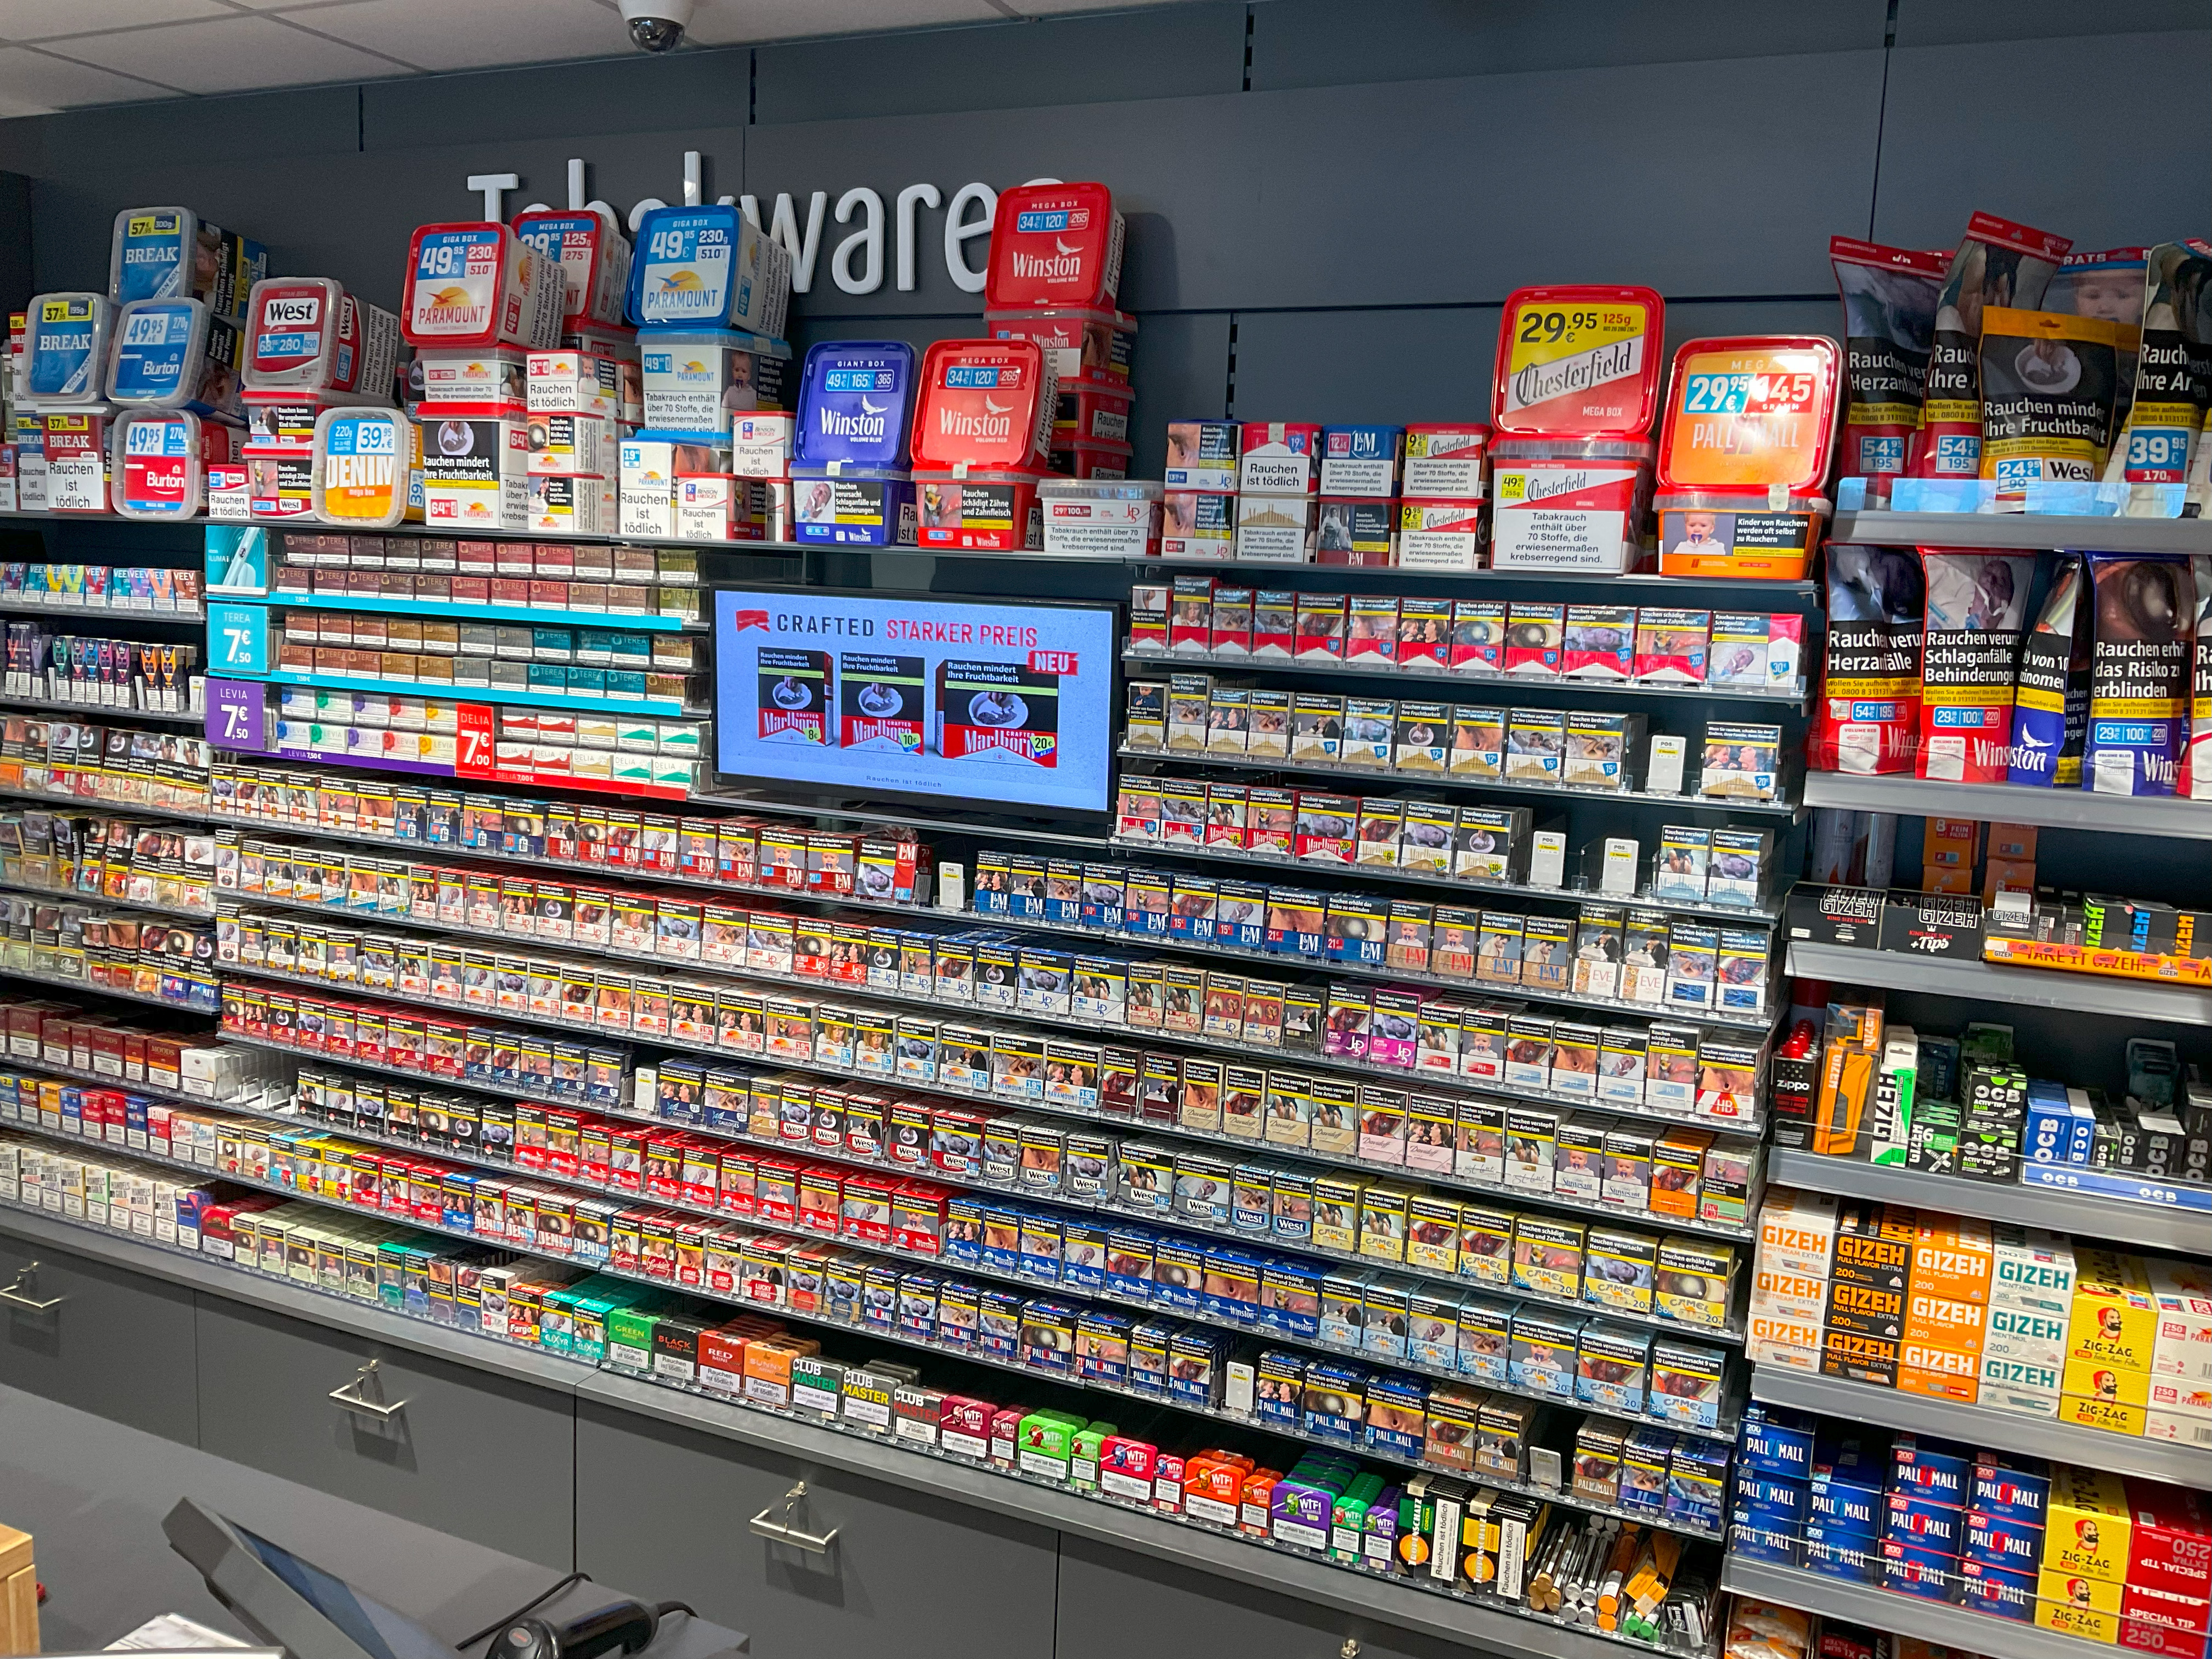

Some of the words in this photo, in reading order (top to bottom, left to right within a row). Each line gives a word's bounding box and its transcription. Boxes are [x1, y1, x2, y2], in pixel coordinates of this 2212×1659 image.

[1013, 252, 1081, 276] Winston
[648, 289, 718, 309] PARAMOUNT
[269, 302, 313, 322] West
[419, 306, 486, 324] PARAMOUNT
[1603, 314, 1632, 326] 125g
[39, 335, 91, 351] BREAK
[1516, 342, 1630, 406] Chesterfield
[646, 394, 686, 404] Tabakrauch
[688, 394, 715, 404] enthält
[647, 404, 662, 413] über
[676, 405, 699, 414] Stoffe,
[702, 405, 713, 414] die
[1583, 407, 1605, 417] MEGA
[1607, 407, 1622, 417] BOX
[1984, 401, 2057, 417] Rauchen
[648, 415, 713, 425] erwiesenermaßen
[821, 408, 884, 436] Winston
[941, 408, 1009, 436] Winston
[1985, 419, 2014, 437] Ihre
[49, 435, 89, 448] BREAK
[1431, 438, 1470, 455] Chesterfield
[49, 462, 93, 475] Rauchen
[1250, 463, 1297, 474] Rauchen
[65, 478, 77, 491] ist
[147, 472, 184, 488] Burton
[1248, 476, 1260, 486] ist
[1262, 476, 1299, 486] tödlich
[1528, 472, 1586, 502] Chesterfield
[56, 494, 91, 508] tödlich
[621, 493, 668, 505] Rauchen
[962, 499, 988, 509] schädigt
[990, 500, 1008, 508] Zähne
[636, 508, 649, 519] ist
[836, 506, 874, 515] Behinderungen
[976, 508, 1011, 517] Zahnfleisch
[1533, 513, 1586, 522] Tabakrauch
[1738, 518, 1760, 527] Kinder
[1775, 520, 1808, 528] Rauchern
[625, 522, 661, 534] tödlich
[1531, 523, 1563, 532] enthält
[1566, 524, 1586, 532] über
[1737, 526, 1762, 535] werden
[1764, 527, 1773, 535] oft
[1775, 527, 1796, 535] selbst
[1528, 533, 1539, 541] 70
[1542, 533, 1571, 542] Stoffe,
[1575, 534, 1588, 542] die
[1746, 534, 1778, 543] Rauchern
[1516, 543, 1598, 552] erwiesenermaßen
[1510, 553, 1577, 564] krebserregend
[1581, 554, 1602, 563] sind.
[174, 572, 194, 580] VEEV
[224, 612, 250, 622] TEREA
[777, 614, 874, 637] CRAFTED
[887, 619, 972, 644] STARKER
[980, 625, 1037, 647] PREIS
[1928, 633, 1988, 646] Rauchen
[1035, 654, 1069, 672] NEU
[1828, 652, 1912, 670] Herzanfälle
[948, 662, 983, 672] Rauchen
[985, 664, 1016, 674] mindert
[2095, 662, 2124, 677] das
[2128, 662, 2168, 678] Risiko
[948, 671, 964, 680] Ihre
[966, 672, 1018, 683] Fruchtbarkeit
[220, 689, 247, 699] LEVIA
[2094, 682, 2167, 698] erblinden
[461, 714, 489, 726] DELIA
[866, 775, 898, 784] Rauchen
[915, 779, 941, 788] tödlich
[738, 863, 753, 878] L&M
[1919, 909, 1977, 928] GIZEH
[1593, 970, 1613, 981] EVE
[1778, 1080, 1809, 1091] zippo
[1976, 1085, 2021, 1103] OCB
[1717, 1098, 1734, 1113] HB
[1874, 1074, 1897, 1141] GIZEH
[783, 1124, 806, 1136] West
[2042, 1172, 2078, 1186] OCB
[2139, 1187, 2177, 1201] OCB
[1237, 1210, 1263, 1223] West
[1590, 1237, 1613, 1246] Rauchen
[1614, 1243, 1643, 1252] verursacht
[1762, 1224, 1826, 1254] GIZEH
[1589, 1243, 1620, 1254] Herzanfälle
[1838, 1235, 1905, 1265] GIZEH
[1661, 1252, 1684, 1262] Rauchen
[1686, 1257, 1705, 1265] erhöht
[1917, 1248, 1985, 1276] GIZEH
[1686, 1263, 1713, 1273] erblinden
[1855, 1258, 1880, 1268] FLAVOR
[1881, 1263, 1903, 1273] EXTRA
[2000, 1261, 2069, 1290] GIZEH
[1598, 1284, 1636, 1298] CAMEL
[1998, 1282, 2035, 1293] MENTHOL
[510, 1324, 532, 1334] Fargo
[615, 1325, 645, 1337] GREEN
[659, 1335, 691, 1350] BLACK
[2083, 1340, 2132, 1357] ZIG-ZAG
[708, 1348, 732, 1360] RED
[794, 1359, 821, 1374] CLUB
[793, 1372, 837, 1391] MASTER
[1664, 1397, 1702, 1413] CAMEL
[1747, 1438, 1769, 1455] PALL
[1779, 1444, 1803, 1462] MALL
[1898, 1465, 1921, 1482] PALL
[1932, 1471, 1957, 1489] MALL
[1436, 1541, 1444, 1576] Rauchen
[2062, 1551, 2110, 1569] ZIG-ZAG
[2130, 1609, 2172, 1627] SPECIAL
[2175, 1616, 2195, 1629] TIP
